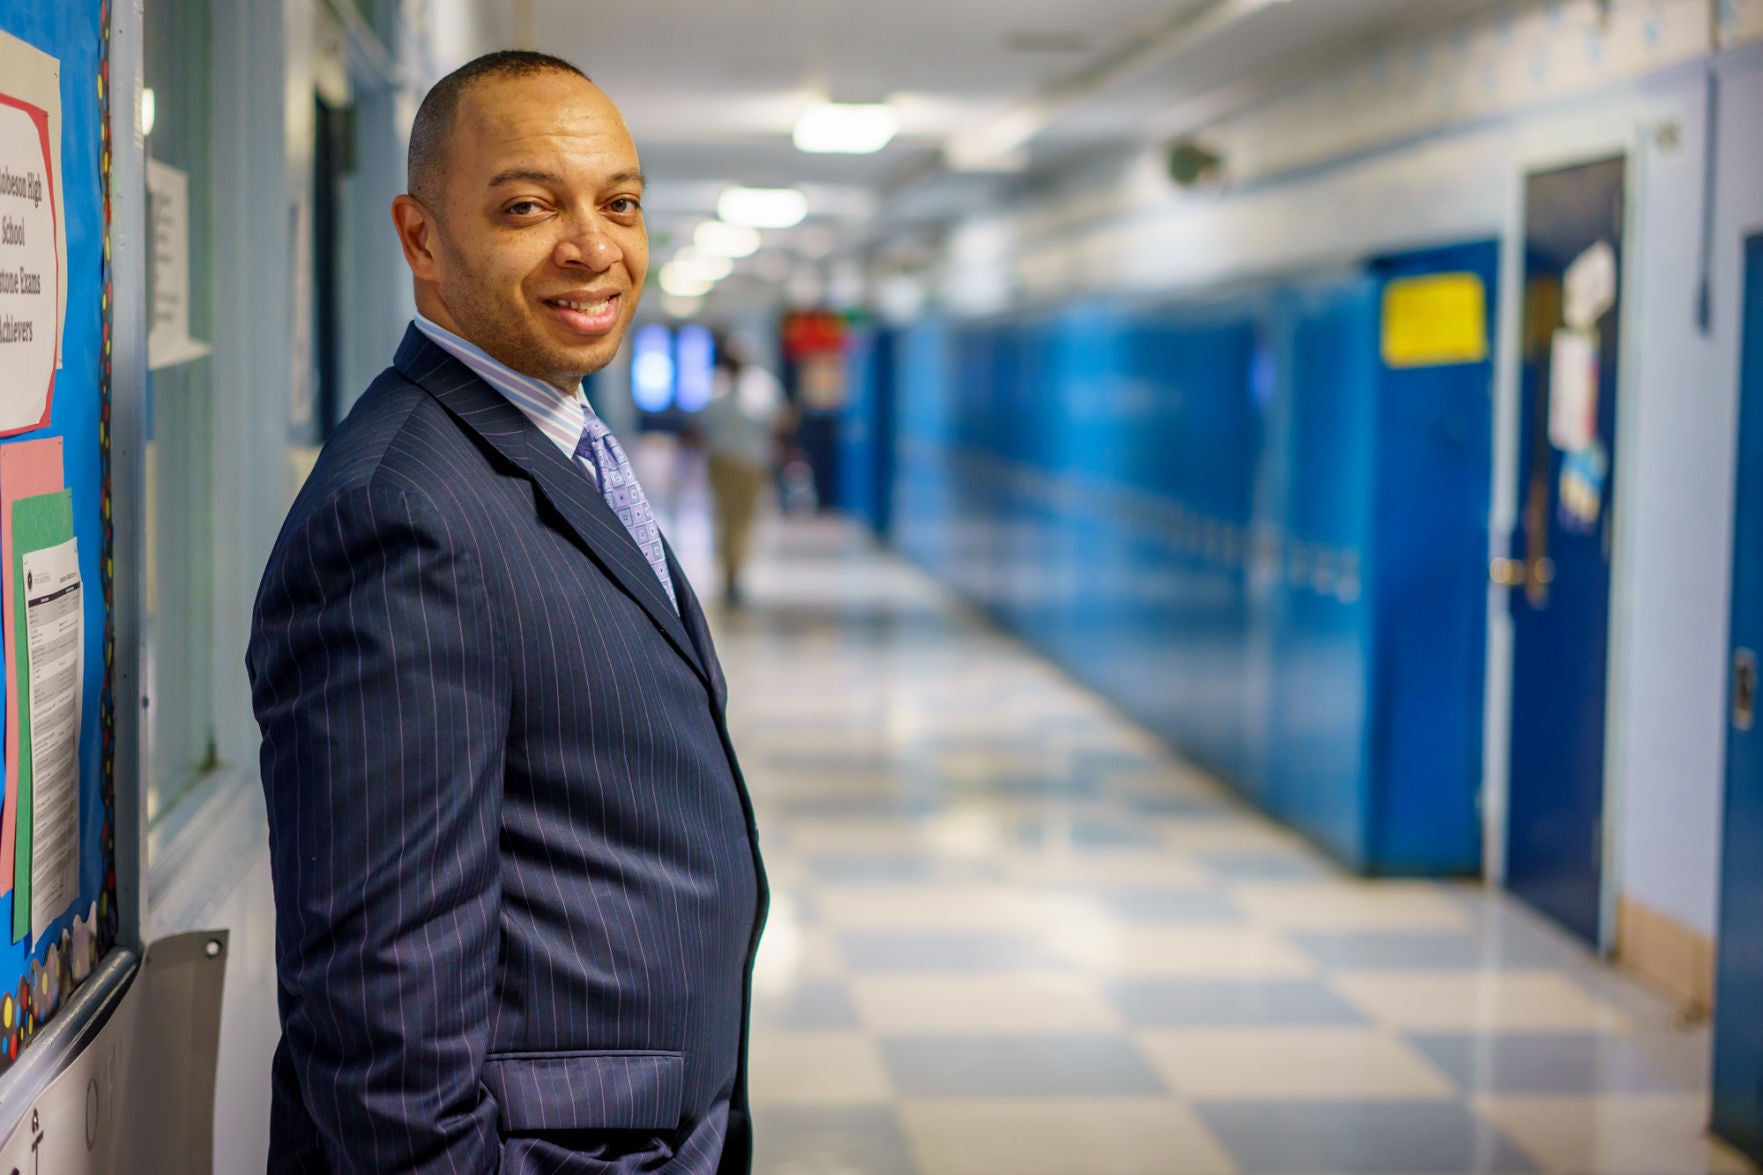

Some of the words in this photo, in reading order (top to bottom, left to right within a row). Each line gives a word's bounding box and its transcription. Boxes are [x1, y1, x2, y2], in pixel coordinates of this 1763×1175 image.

[0, 165, 27, 199] obeson
[27, 171, 42, 208] High
[2, 215, 25, 247] School
[20, 266, 41, 294] Exams
